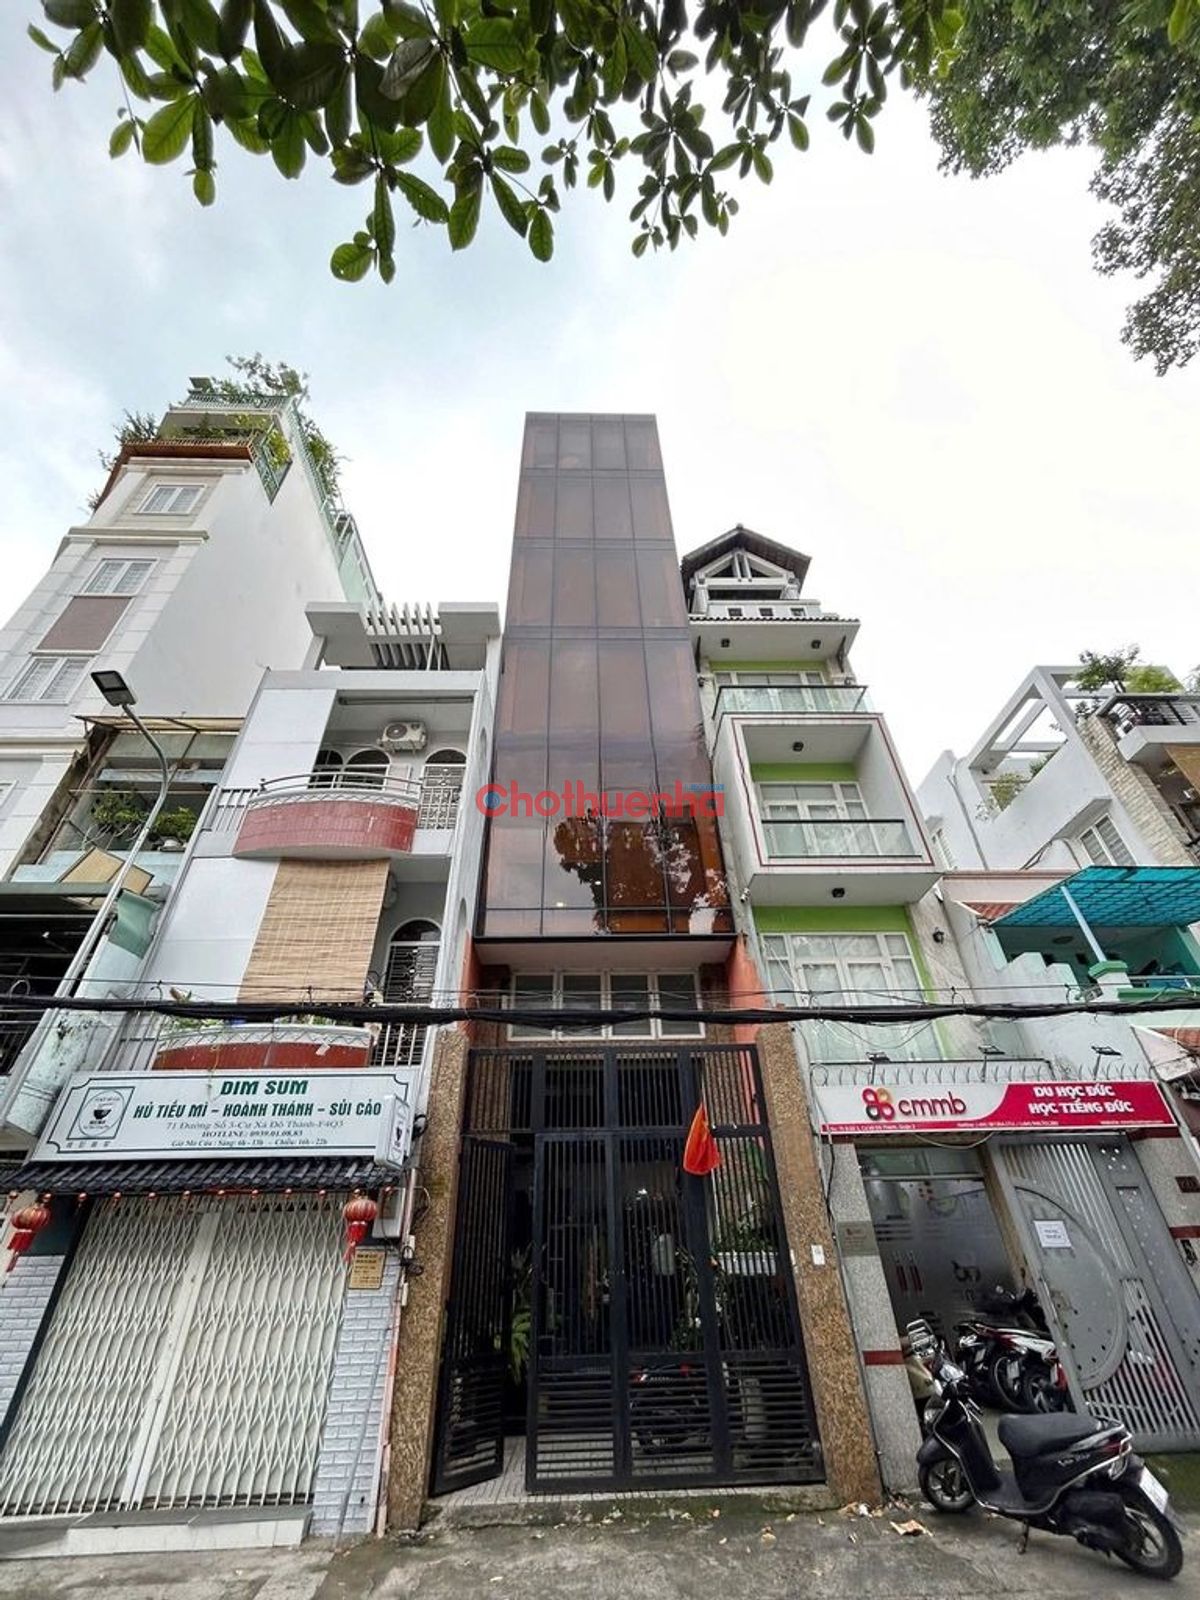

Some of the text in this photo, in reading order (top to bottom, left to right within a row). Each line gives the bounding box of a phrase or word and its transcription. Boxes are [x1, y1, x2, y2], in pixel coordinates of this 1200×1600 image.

[220, 1080, 309, 1095] DIM SUM
[1056, 1086, 1086, 1100] HỌC
[1085, 1083, 1115, 1097] ĐỨC
[133, 1101, 154, 1119] HỦ
[222, 1099, 268, 1117] HOÀNH
[898, 1090, 967, 1116] cmmb
[1028, 1099, 1135, 1117] HỌC TIẾNG ĐỨC
